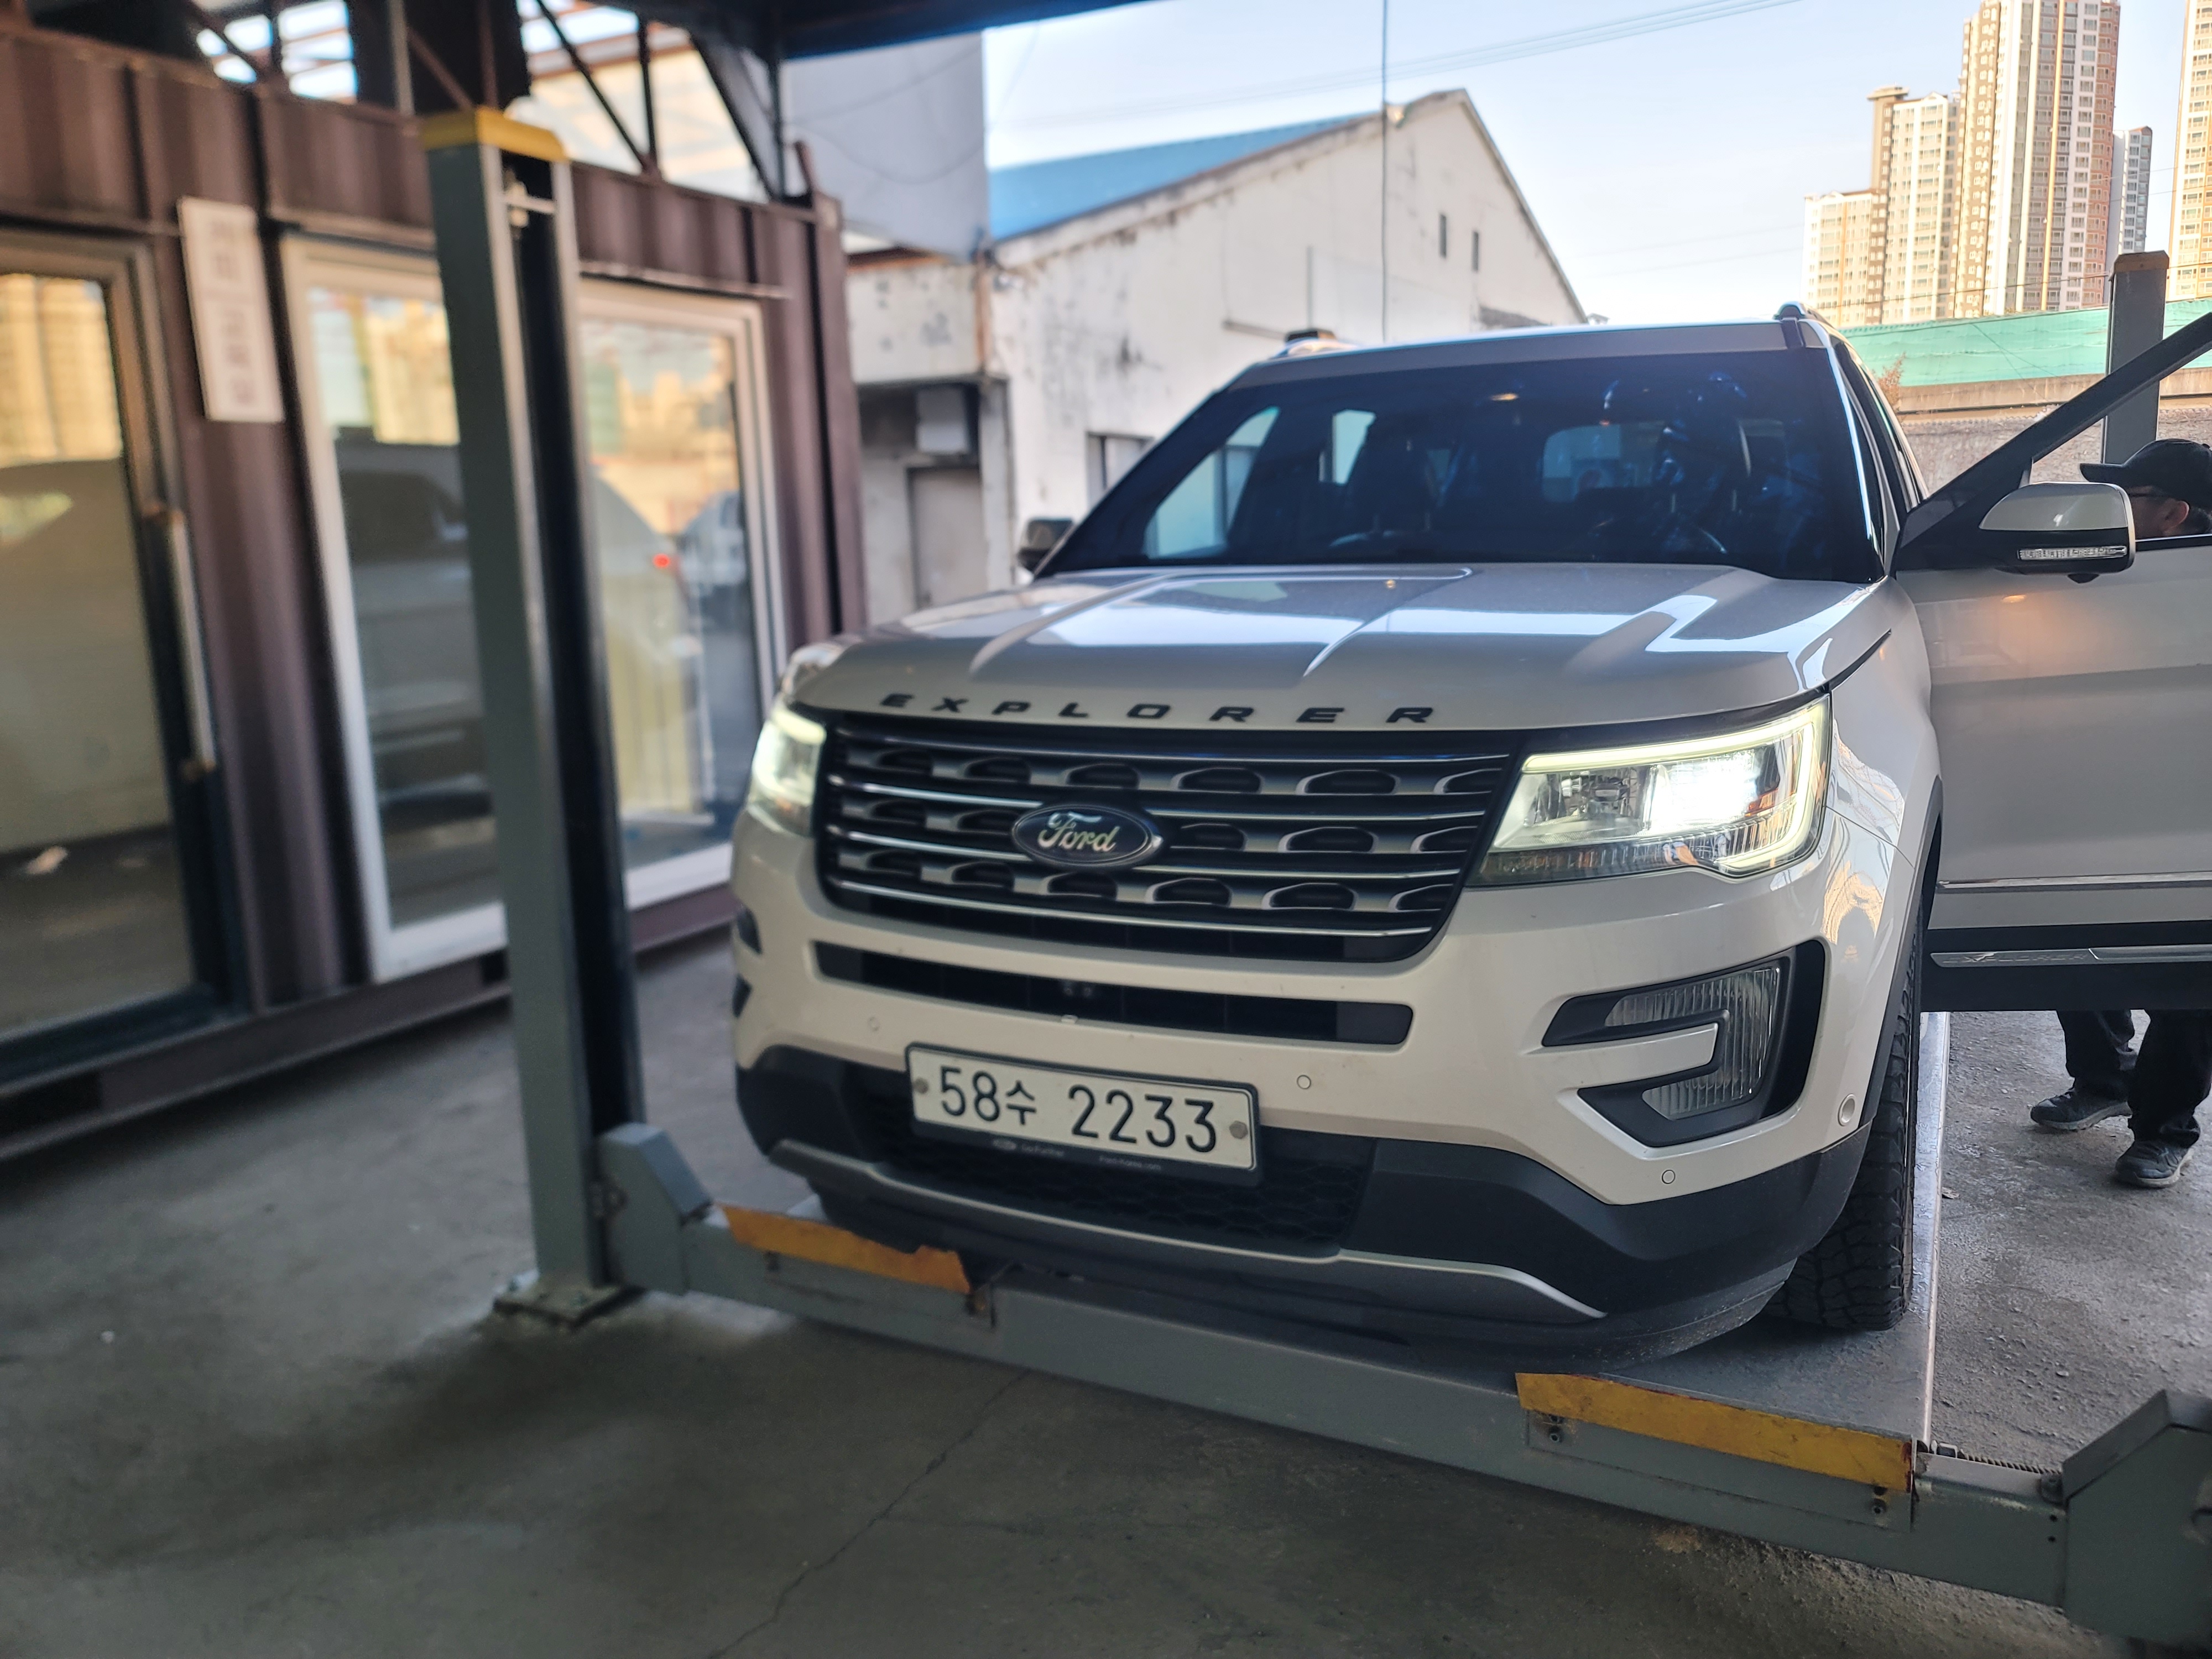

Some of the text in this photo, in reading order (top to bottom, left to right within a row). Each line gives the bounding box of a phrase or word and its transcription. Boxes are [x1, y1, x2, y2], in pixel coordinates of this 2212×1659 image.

[880, 693, 1433, 724] EXPLORER
[1037, 811, 1120, 852] Ford
[940, 1065, 1217, 1153] 58수 2233
